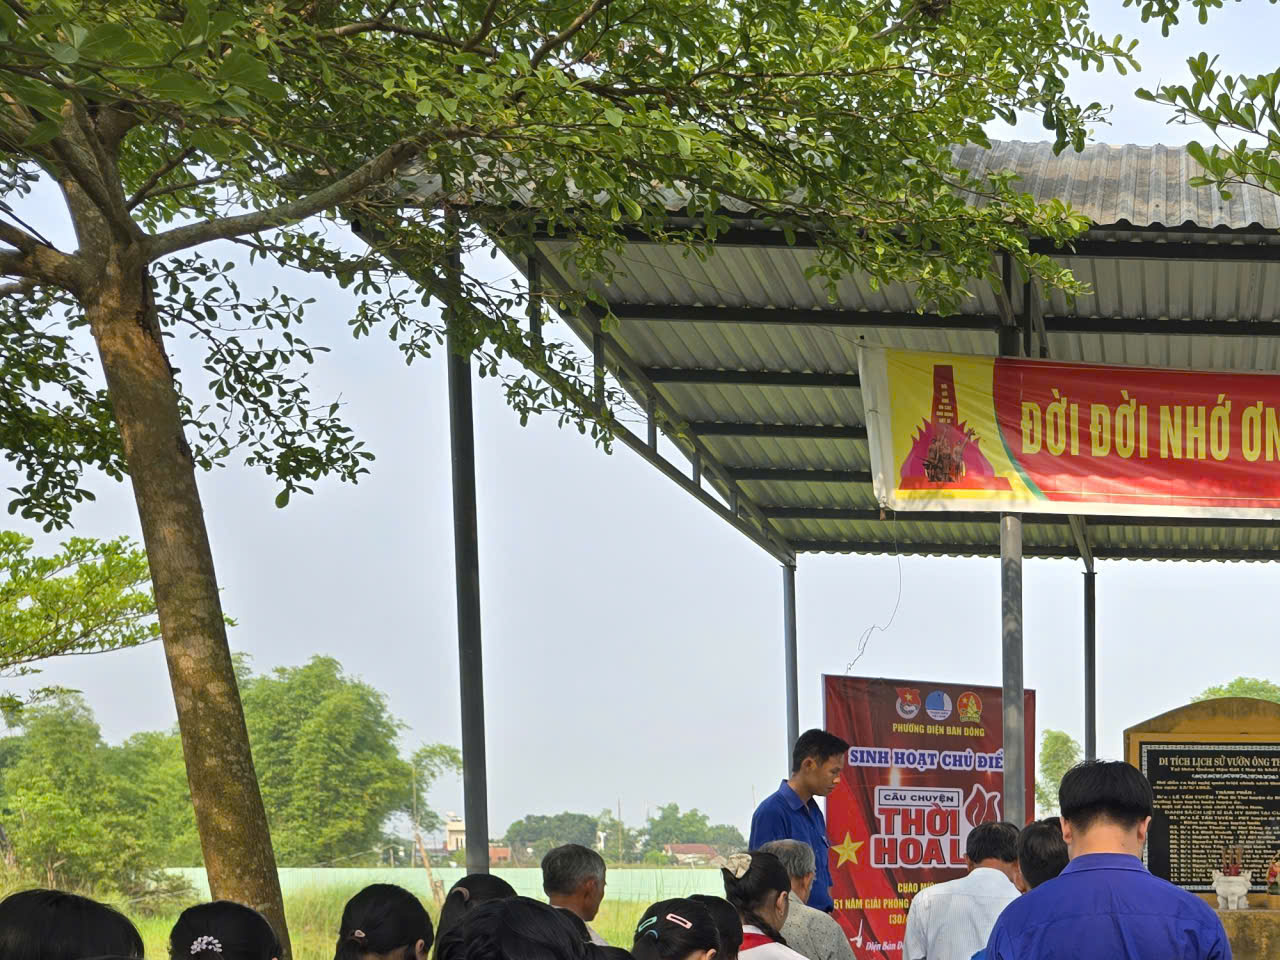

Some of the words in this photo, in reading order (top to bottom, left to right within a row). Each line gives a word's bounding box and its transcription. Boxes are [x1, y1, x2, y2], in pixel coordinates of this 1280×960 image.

[1020, 388, 1079, 456] ĐỜI
[1089, 390, 1148, 458] ĐỜI
[1160, 393, 1231, 461] NHỚ
[850, 749, 889, 764] SINH
[894, 750, 937, 769] HOẠT
[941, 749, 973, 768] CHỦ
[977, 750, 1003, 769] ĐIỂ
[1158, 757, 1169, 766] DI
[1170, 755, 1190, 766] TÍCH
[1192, 757, 1213, 768] LỊCH
[1214, 754, 1226, 766] SỬ
[1227, 756, 1250, 767] VƯỜN
[1252, 755, 1270, 767] ÔNG
[883, 793, 907, 802] CÂU
[910, 794, 954, 803] CHUYỆN
[878, 802, 960, 837] THỜI
[874, 838, 946, 865] HOA
[834, 898, 843, 909] 51
